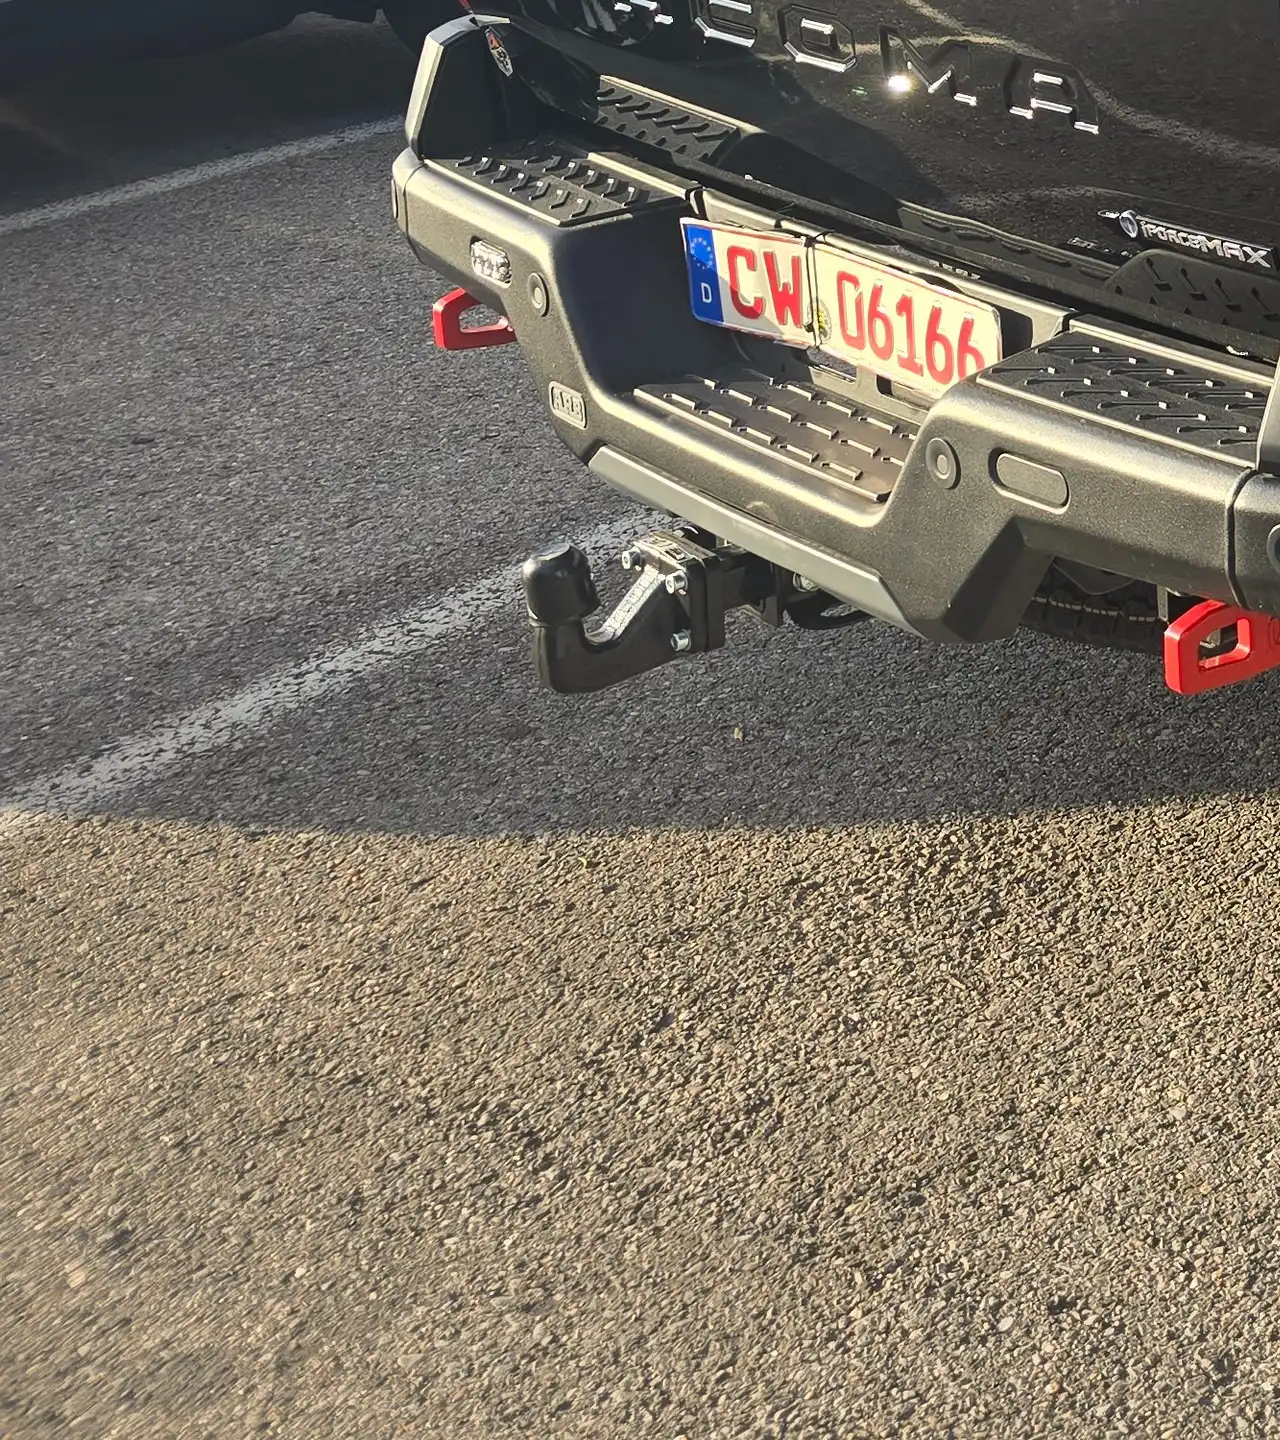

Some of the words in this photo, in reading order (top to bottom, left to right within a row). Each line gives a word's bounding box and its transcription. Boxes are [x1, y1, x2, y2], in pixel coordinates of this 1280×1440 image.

[700, 282, 713, 304] D
[726, 245, 804, 329] CW
[836, 270, 986, 385] 06166
[551, 388, 584, 422] ARB
